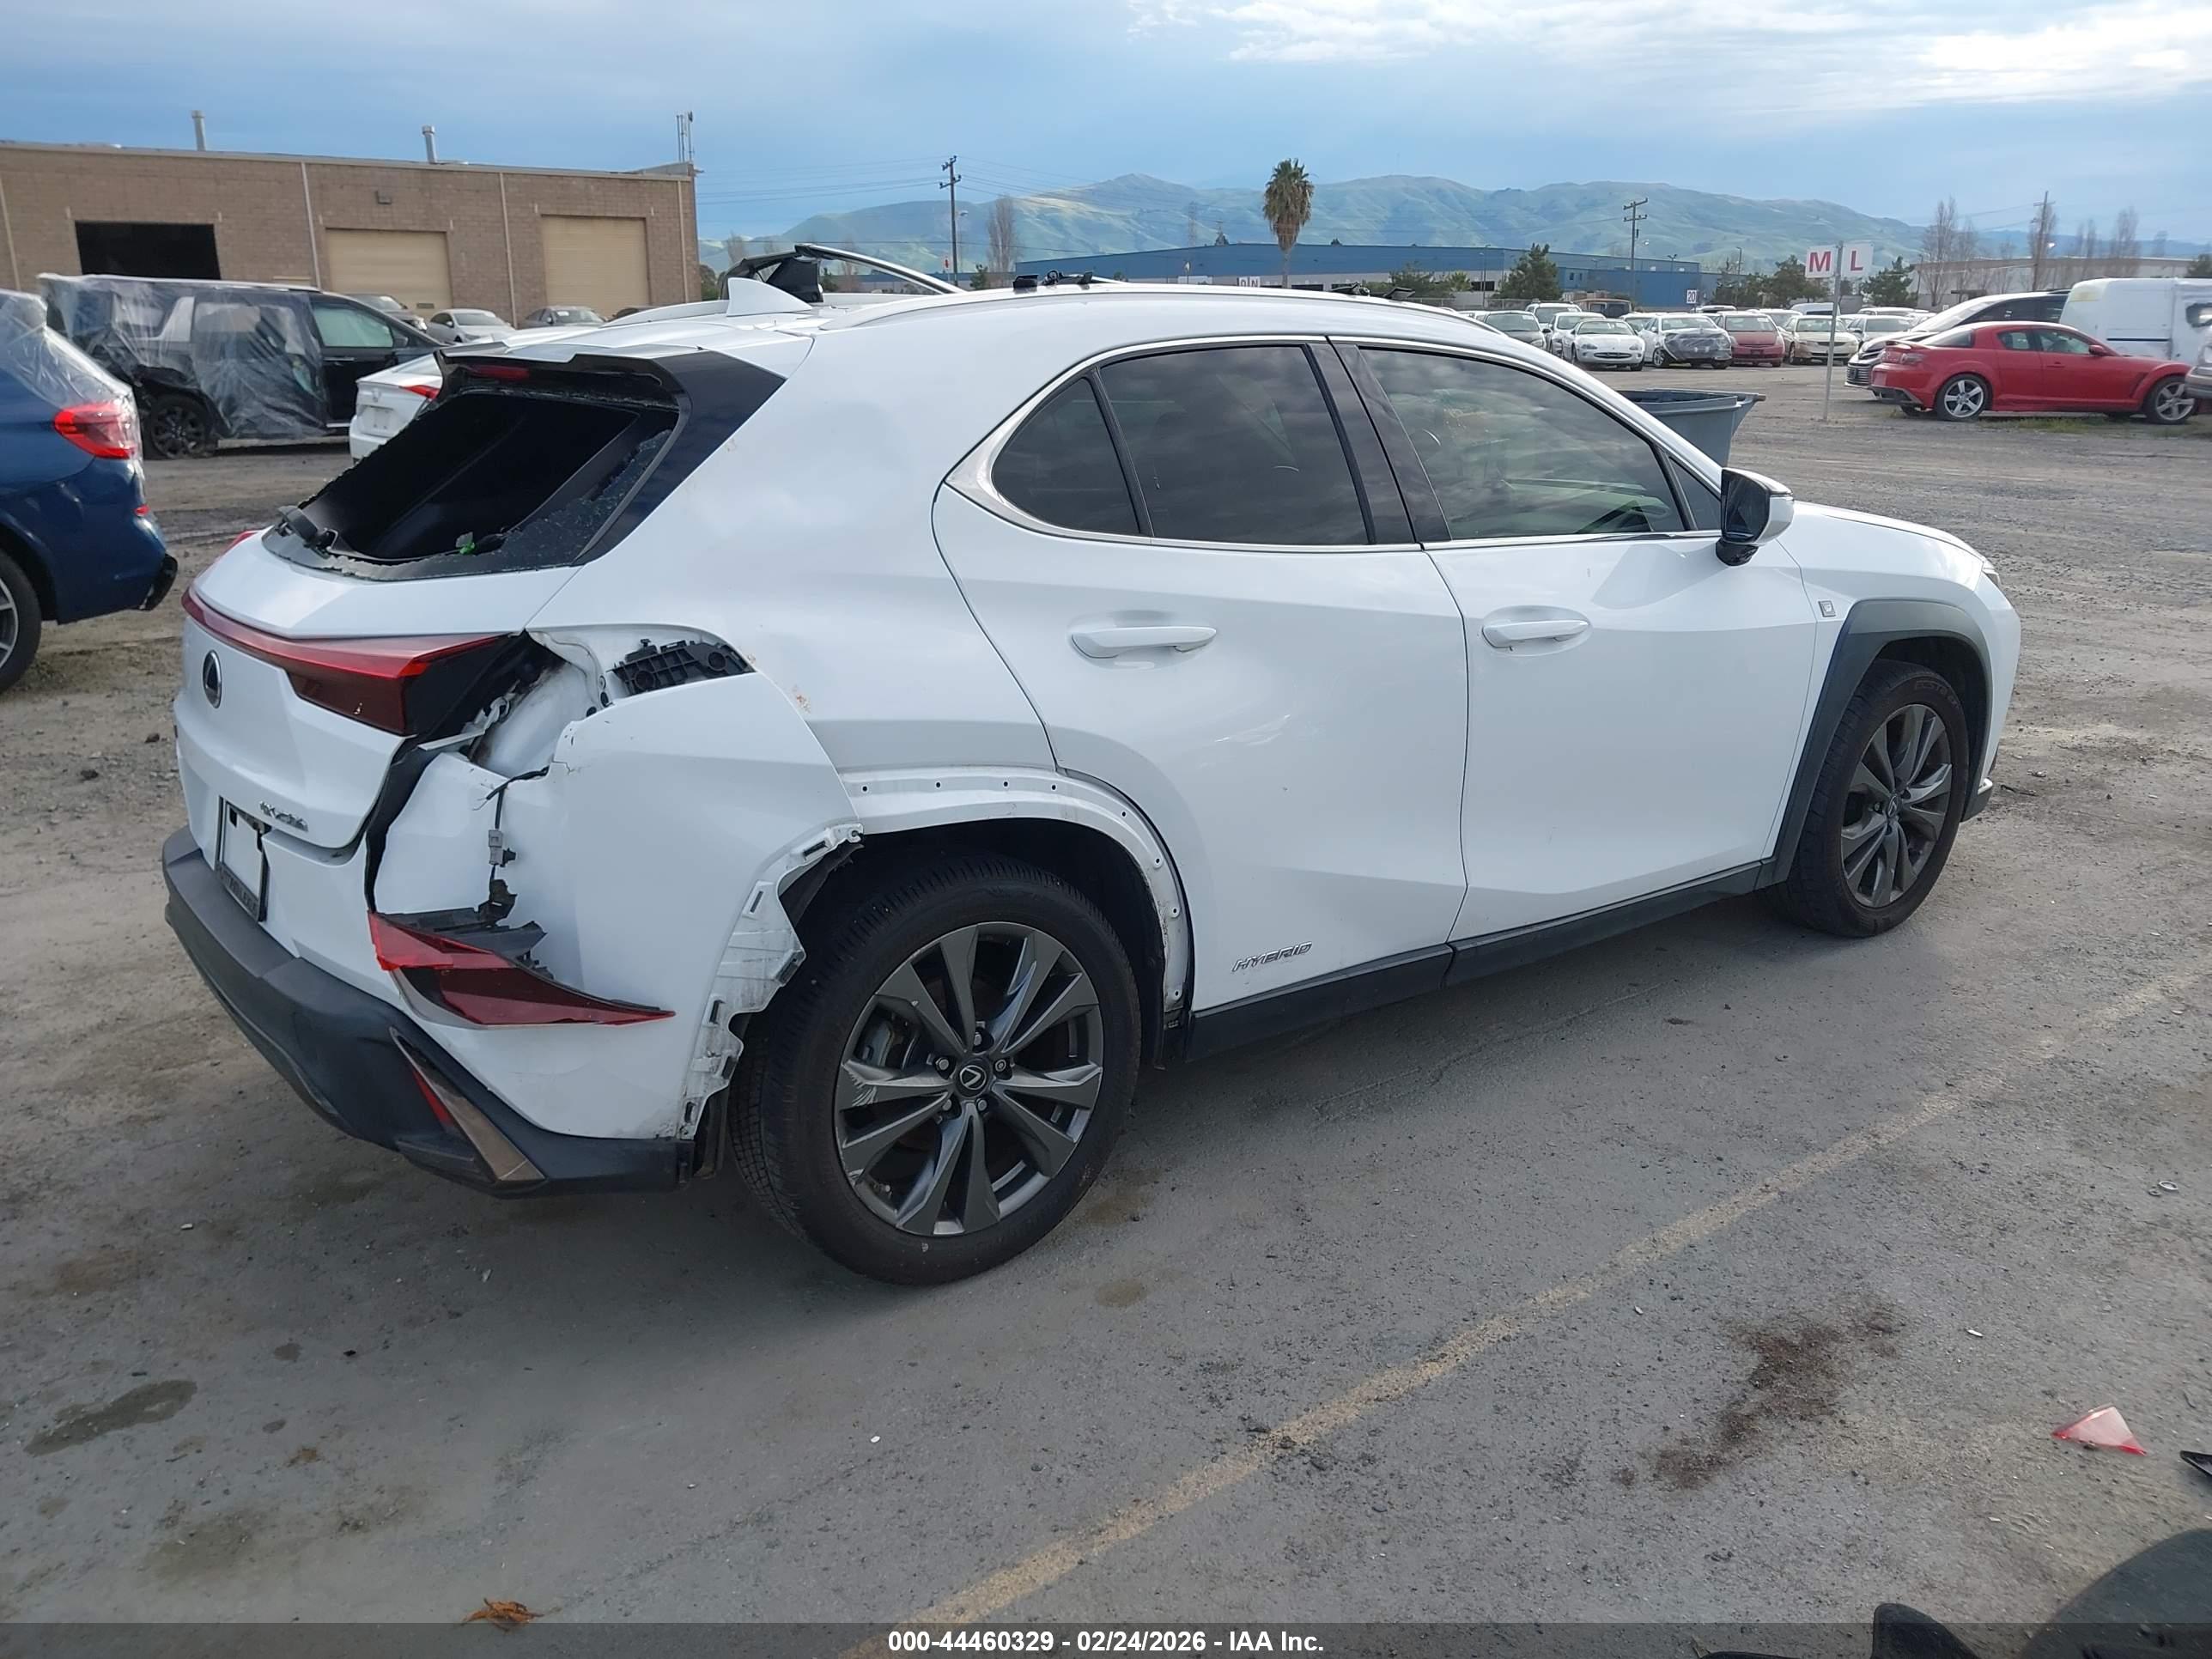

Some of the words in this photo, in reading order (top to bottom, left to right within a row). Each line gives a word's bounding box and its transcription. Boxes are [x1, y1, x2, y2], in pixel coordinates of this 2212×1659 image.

[1809, 251, 1832, 272] M
[1850, 250, 1863, 271] L
[1687, 291, 1696, 302] 20
[1231, 941, 1312, 972] HYBRID
